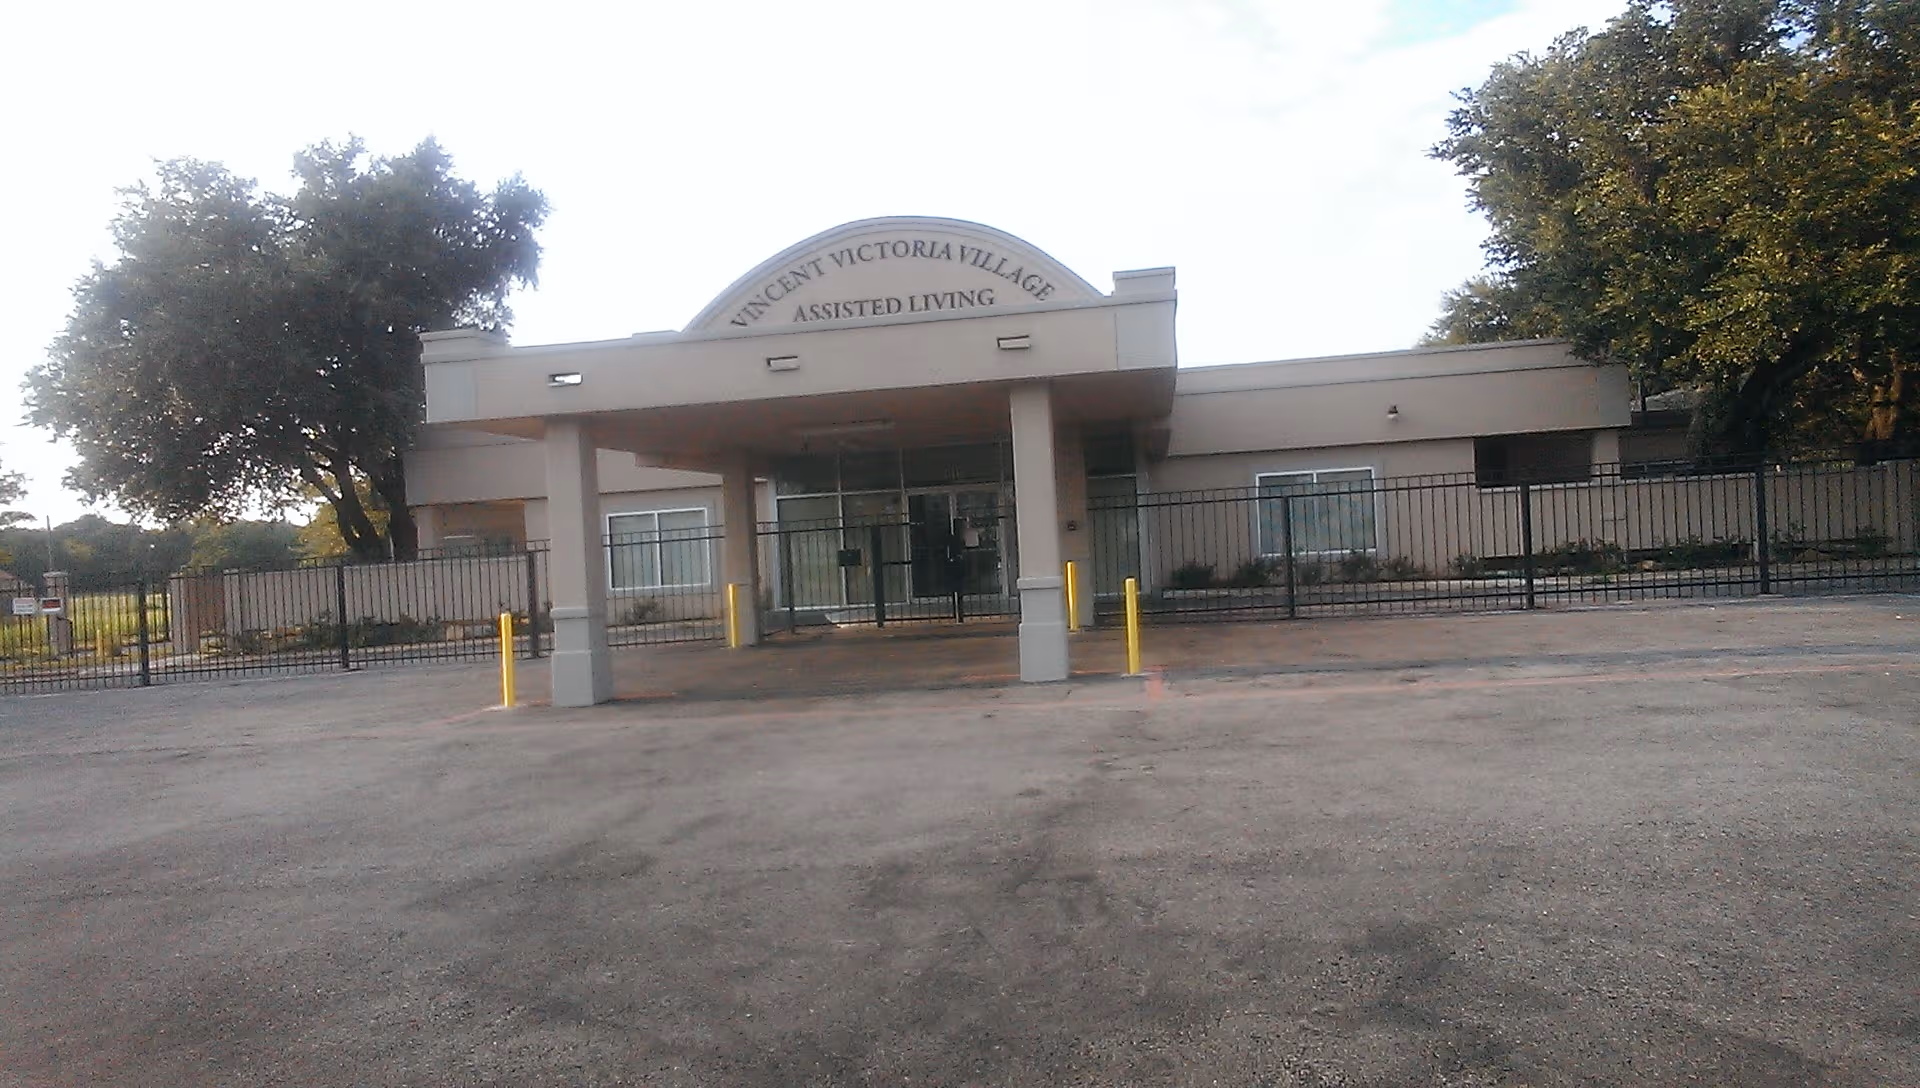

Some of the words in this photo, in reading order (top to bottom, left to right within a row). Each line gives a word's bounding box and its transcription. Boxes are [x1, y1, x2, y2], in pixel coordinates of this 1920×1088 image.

[730, 258, 826, 329] VINCENT
[830, 240, 953, 269] VICTORIA
[960, 244, 1055, 301] VILLAGE
[793, 297, 902, 323] ASSISTED
[910, 288, 995, 312] LIVING
